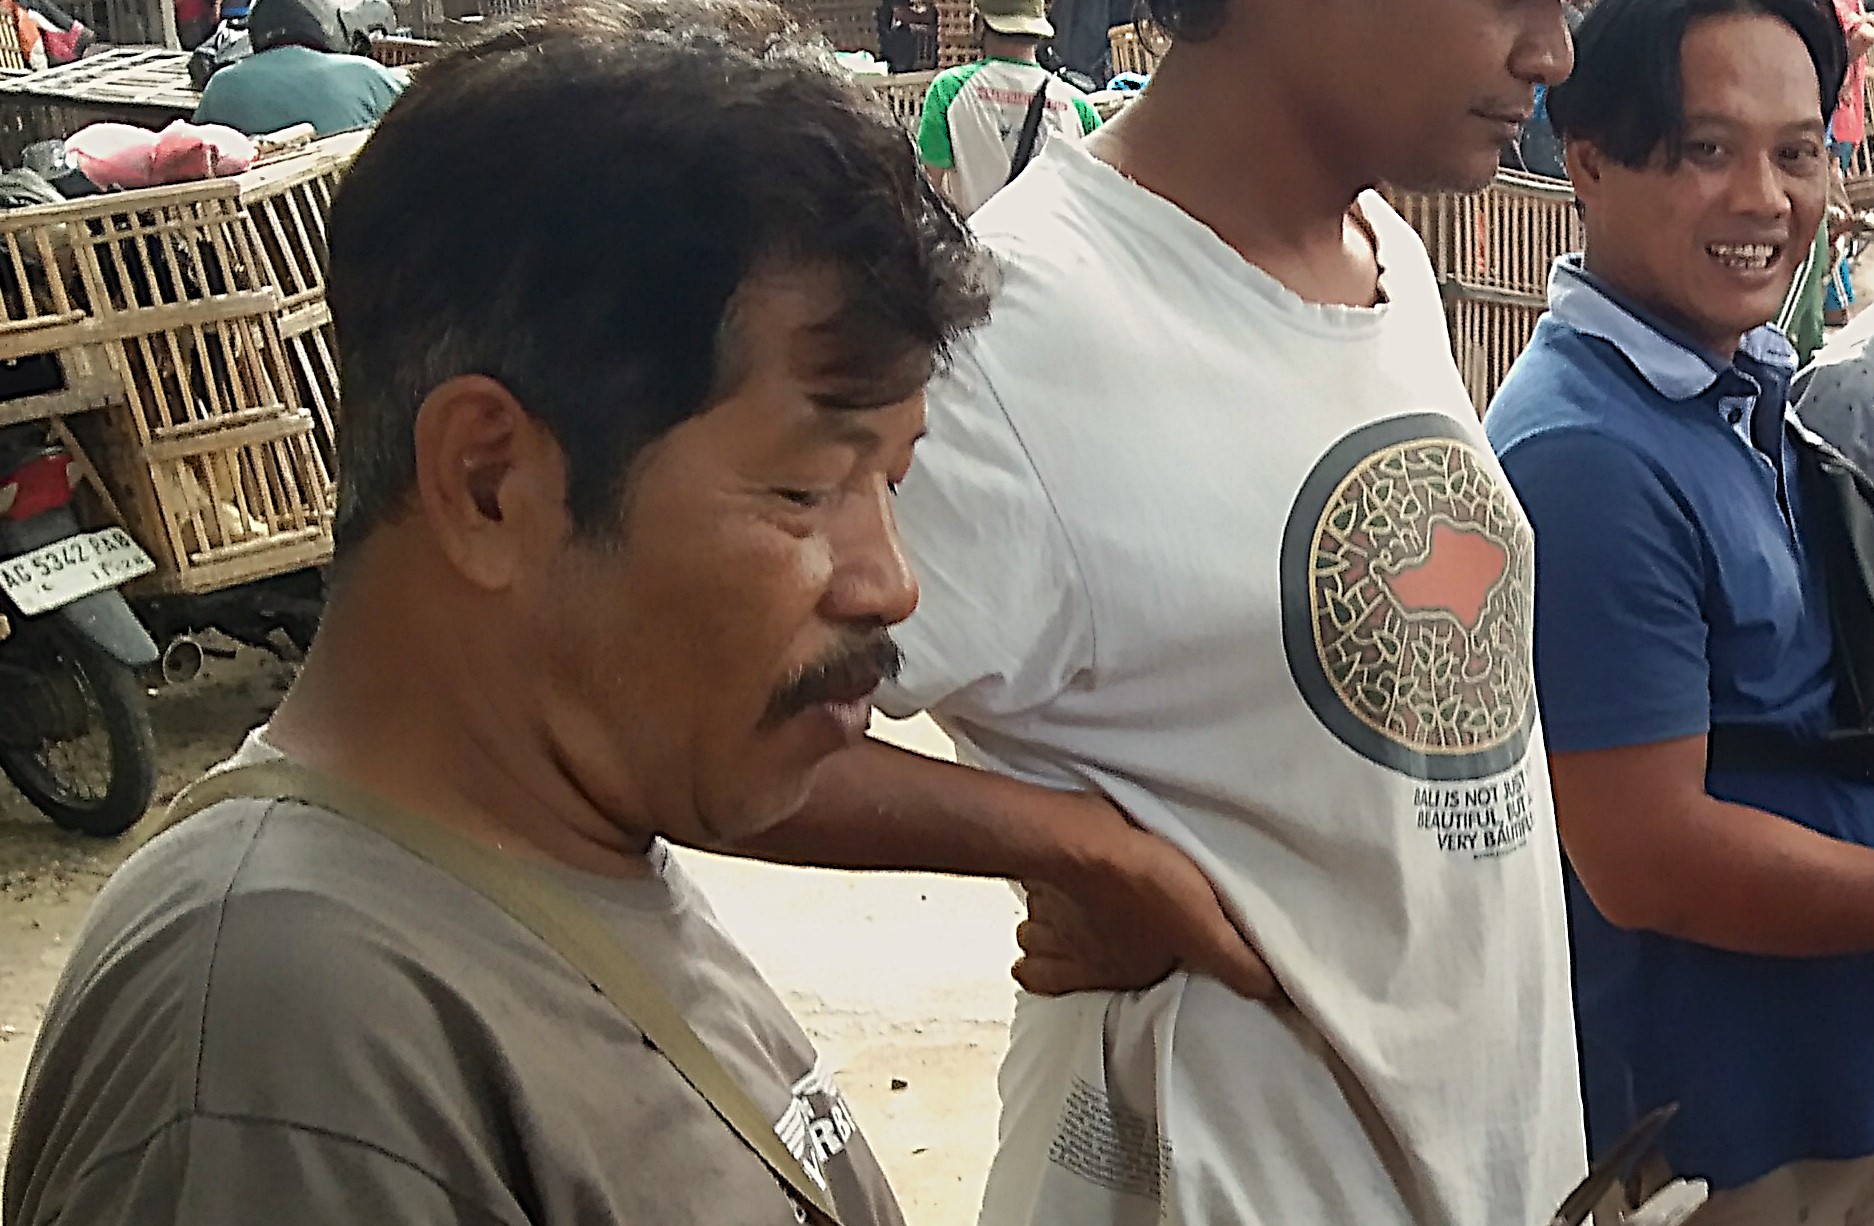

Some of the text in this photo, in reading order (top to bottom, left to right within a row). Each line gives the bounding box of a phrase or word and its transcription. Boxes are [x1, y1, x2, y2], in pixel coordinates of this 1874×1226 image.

[1414, 770, 1526, 808] BALI IS NOT JUST
[1437, 830, 1478, 851] VERY
